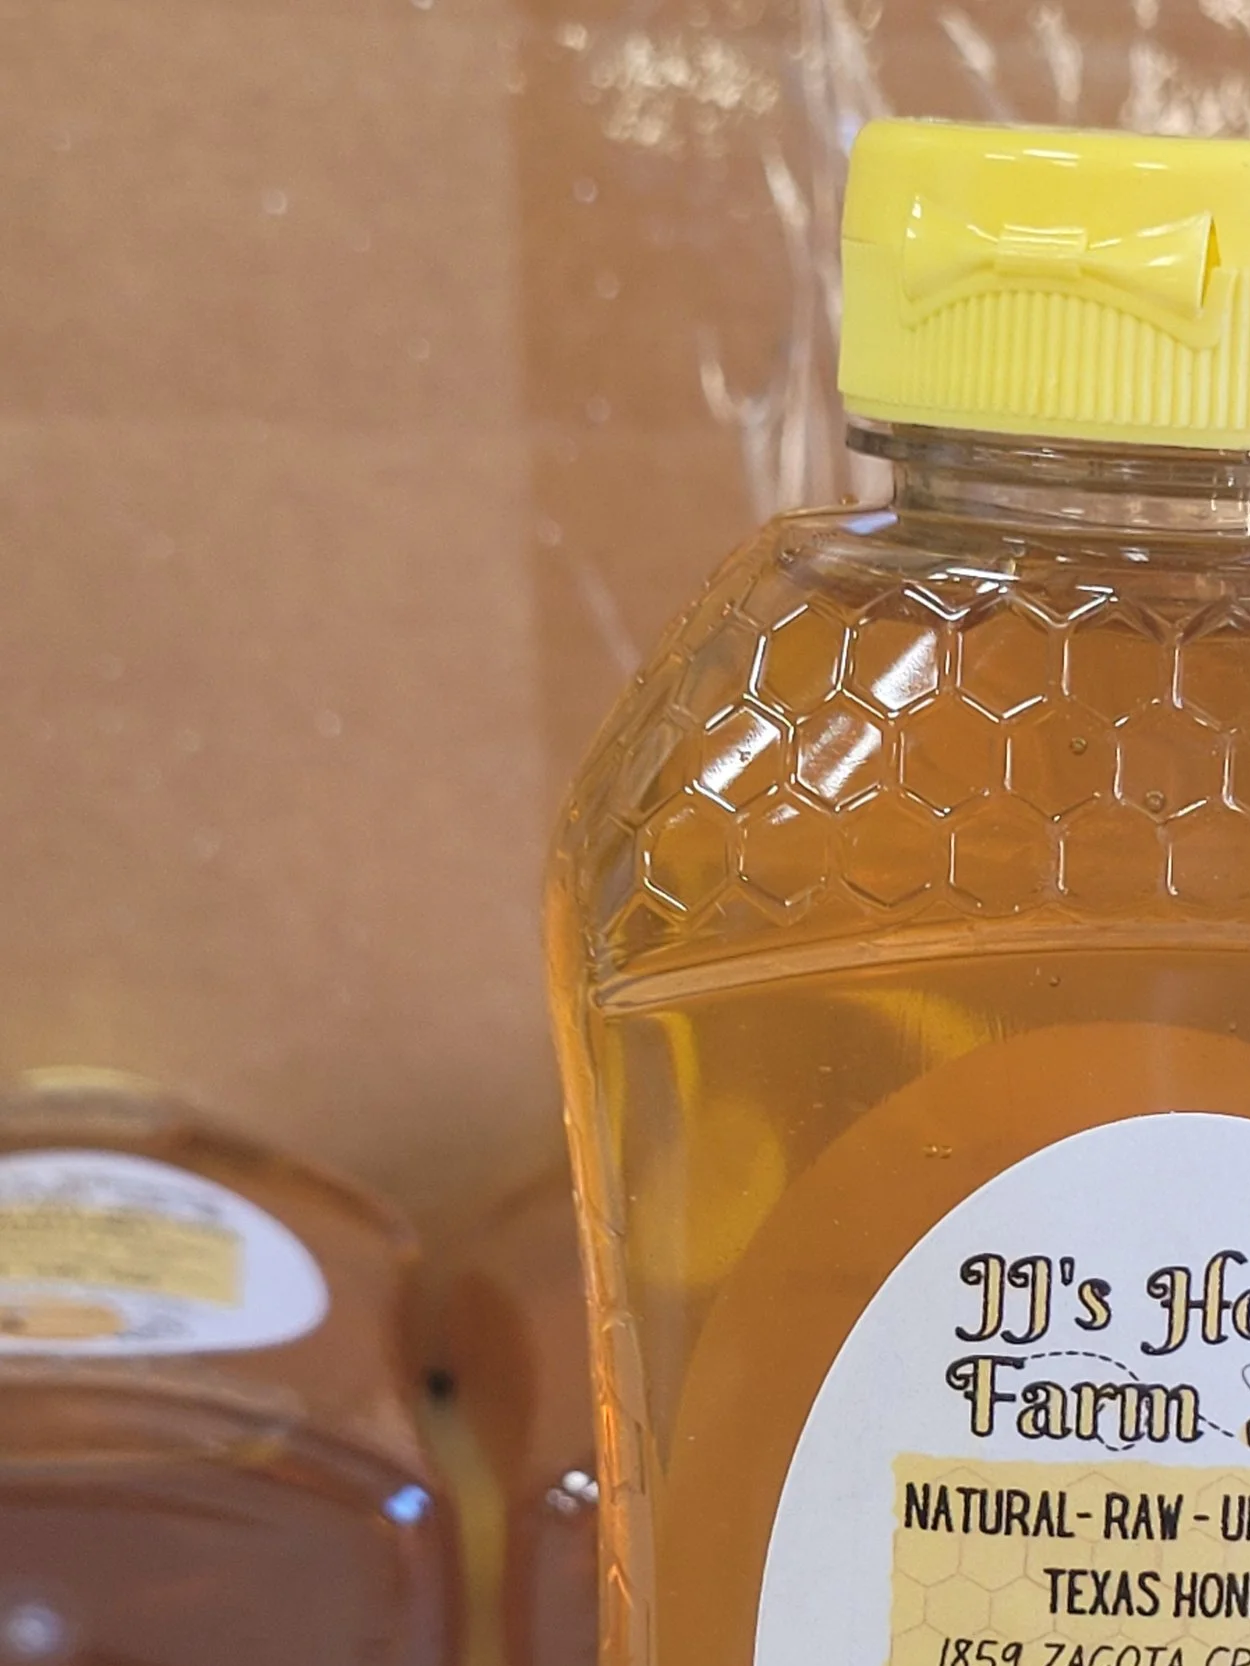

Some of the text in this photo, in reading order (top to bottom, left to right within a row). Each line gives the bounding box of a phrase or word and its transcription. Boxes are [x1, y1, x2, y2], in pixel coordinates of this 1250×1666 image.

[955, 1253, 1112, 1344] JJ's
[945, 1355, 1203, 1443] Farm
[1103, 1493, 1184, 1541] RAW
[1043, 1568, 1161, 1618] TEXAS
